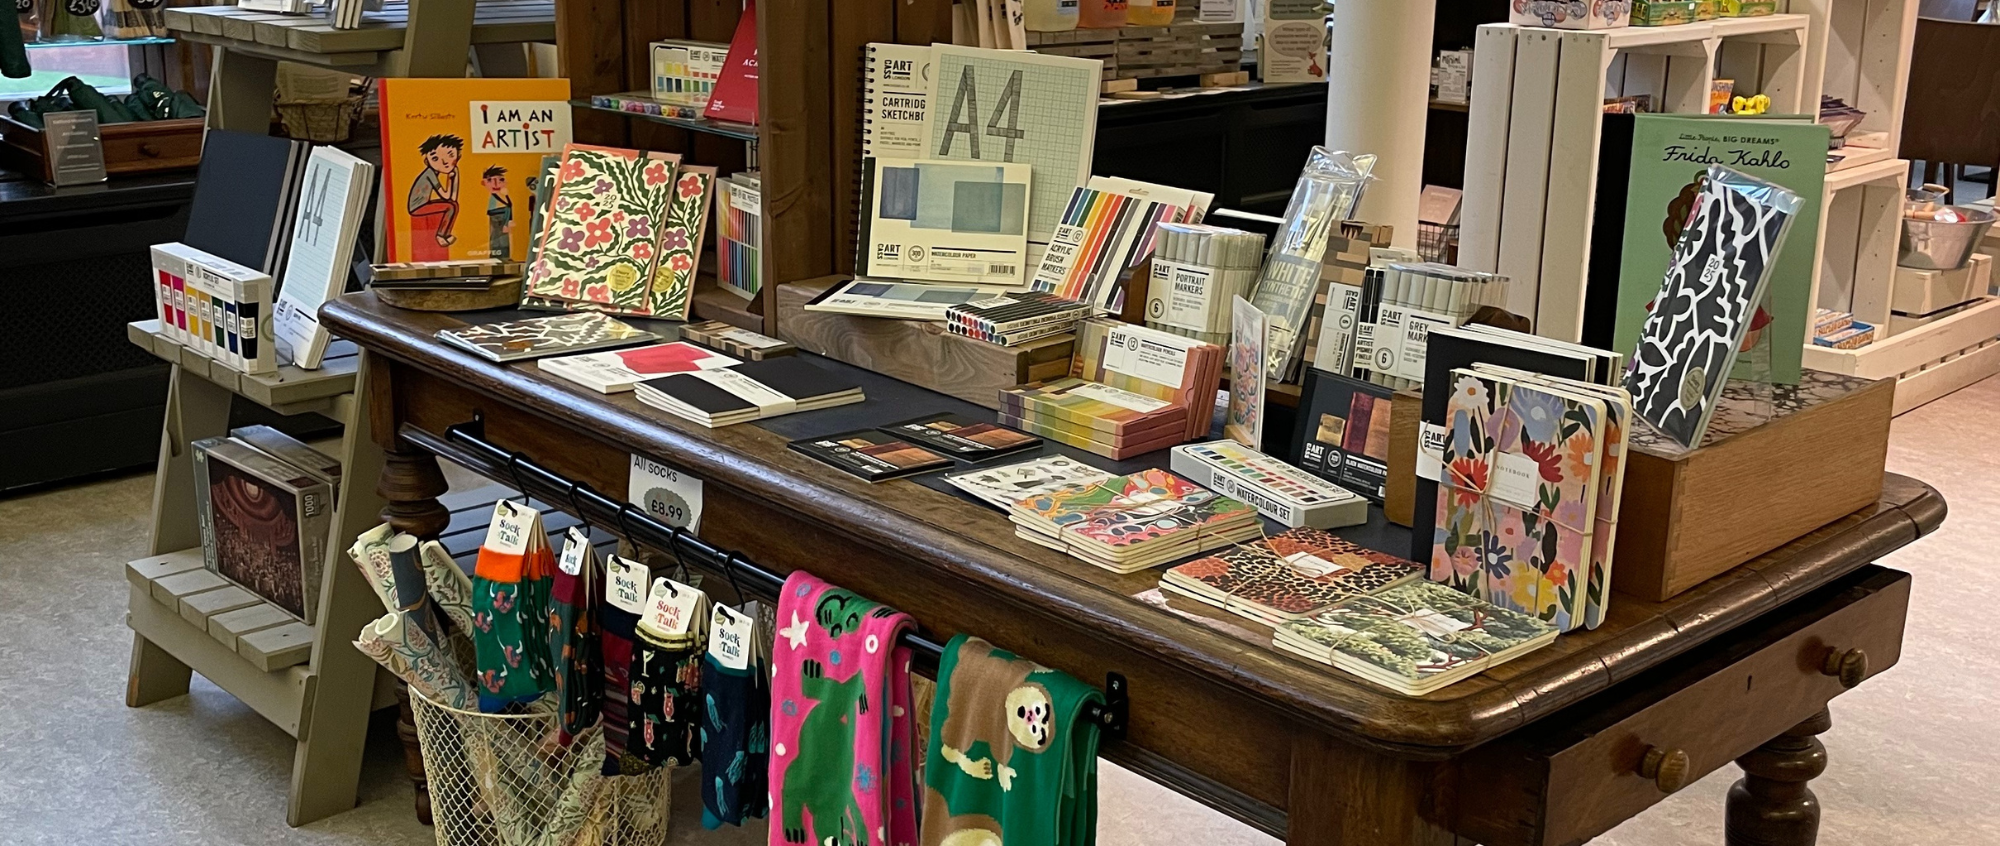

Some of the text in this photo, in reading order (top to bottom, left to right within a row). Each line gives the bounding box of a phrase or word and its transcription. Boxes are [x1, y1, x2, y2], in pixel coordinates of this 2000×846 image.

[884, 60, 892, 80] CASS
[893, 60, 913, 72] ART
[882, 97, 926, 109] CARTRIDG
[497, 110, 521, 122] AM
[529, 110, 552, 122] AN
[938, 64, 1025, 161] A4
[1662, 146, 1790, 168] Frida Kahlo
[603, 200, 614, 208] 25
[884, 244, 900, 252] ART
[1050, 244, 1073, 256] ACRYLIC
[1045, 254, 1064, 264] BRUSH
[1708, 258, 1720, 270] 20
[1041, 263, 1066, 276] MARKERS
[1159, 264, 1170, 274] ART
[1268, 260, 1314, 288] WHITE
[1704, 268, 1716, 282] 25
[1176, 273, 1205, 286] PORTRAIT
[1175, 283, 1204, 295] MARKERS
[1154, 303, 1158, 312] 6
[1348, 297, 1357, 312] ART
[1388, 312, 1402, 320] ART
[1409, 321, 1428, 332] GREY
[1382, 353, 1386, 363] 6
[1311, 444, 1324, 455] ART
[634, 456, 646, 470] All
[1496, 466, 1530, 479] NOTEBOOK
[304, 494, 314, 516] 1000
[652, 500, 682, 520] £8.99
[1236, 486, 1290, 521] WATERCOLOUR SET
[500, 519, 520, 536] Sock
[500, 530, 519, 546] Talk
[616, 576, 637, 594] Sock
[618, 588, 638, 602] Talk
[656, 600, 680, 620] Sock
[658, 614, 678, 630] Talk
[719, 628, 740, 648] Sock
[721, 642, 740, 658] Talk
